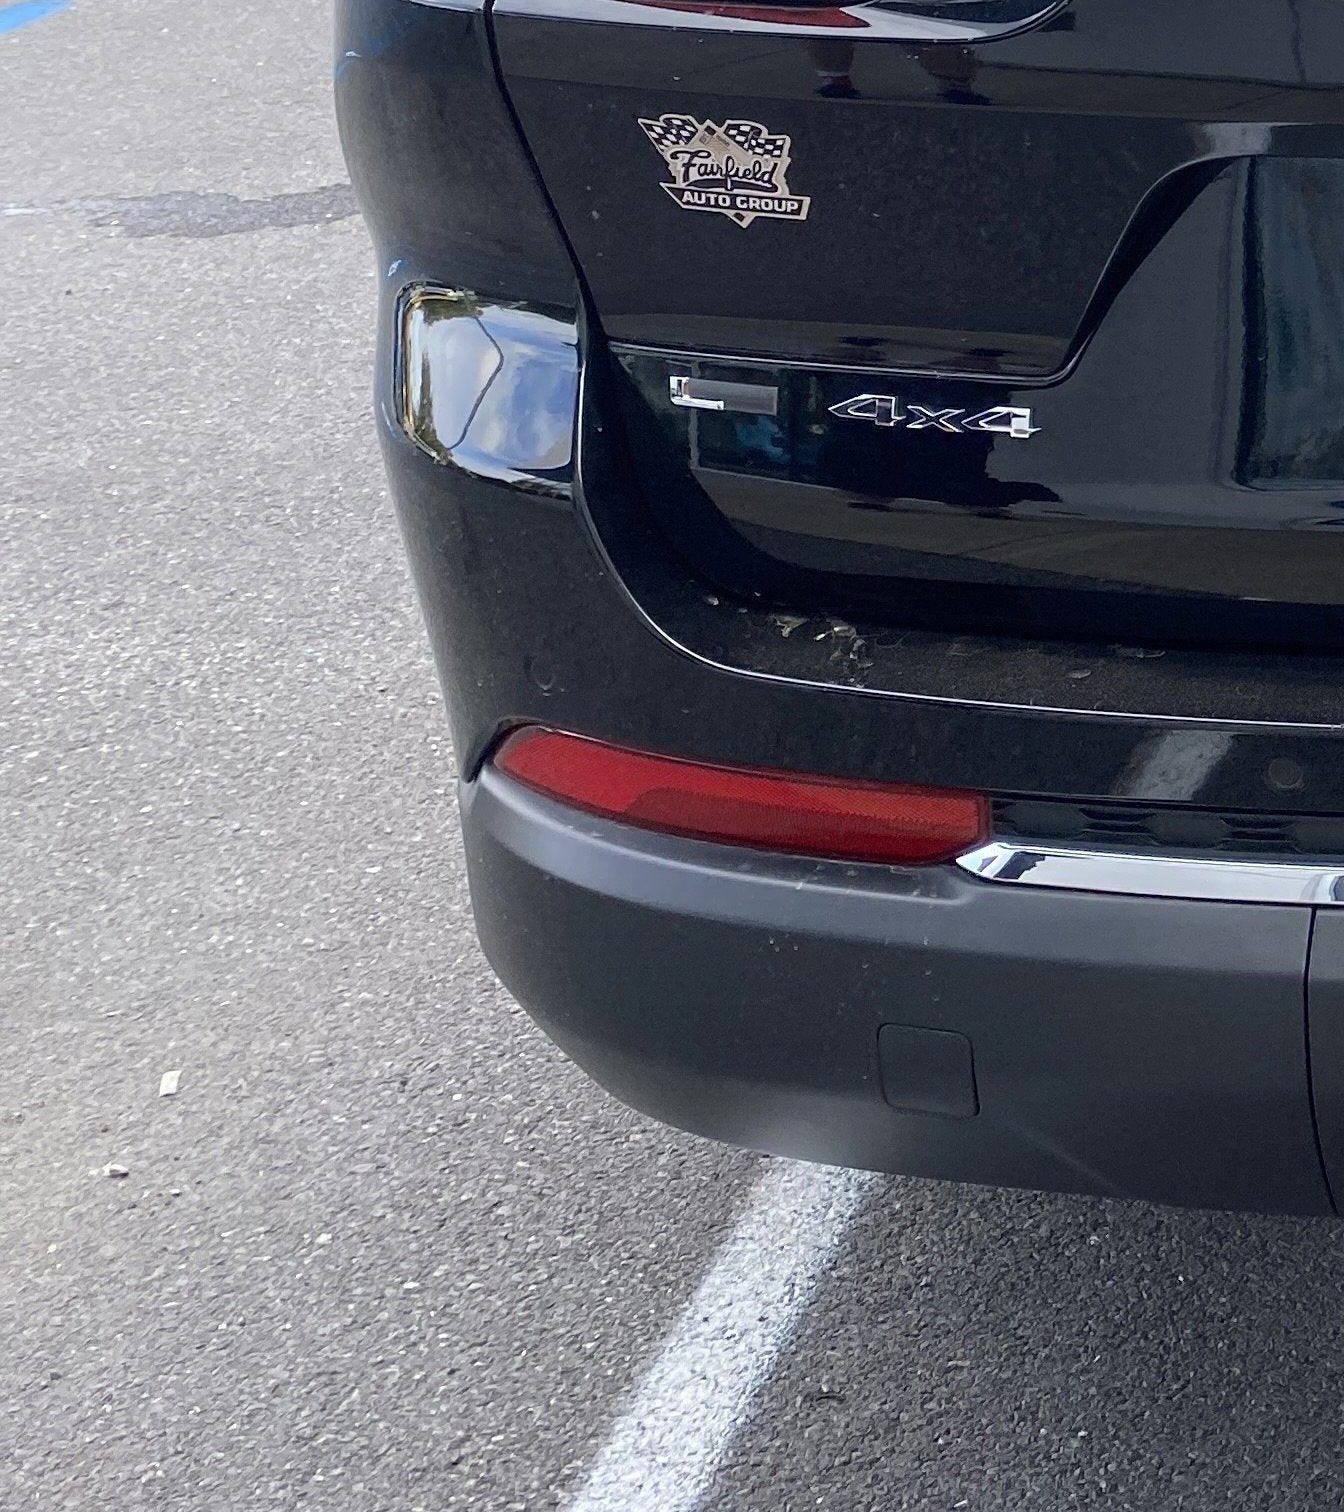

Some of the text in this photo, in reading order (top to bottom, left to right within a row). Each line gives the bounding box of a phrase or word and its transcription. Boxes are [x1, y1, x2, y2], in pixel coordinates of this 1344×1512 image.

[669, 149, 778, 191] Fairfield
[681, 190, 799, 213] AUTO GROUP
[828, 393, 1042, 439] 4x4
